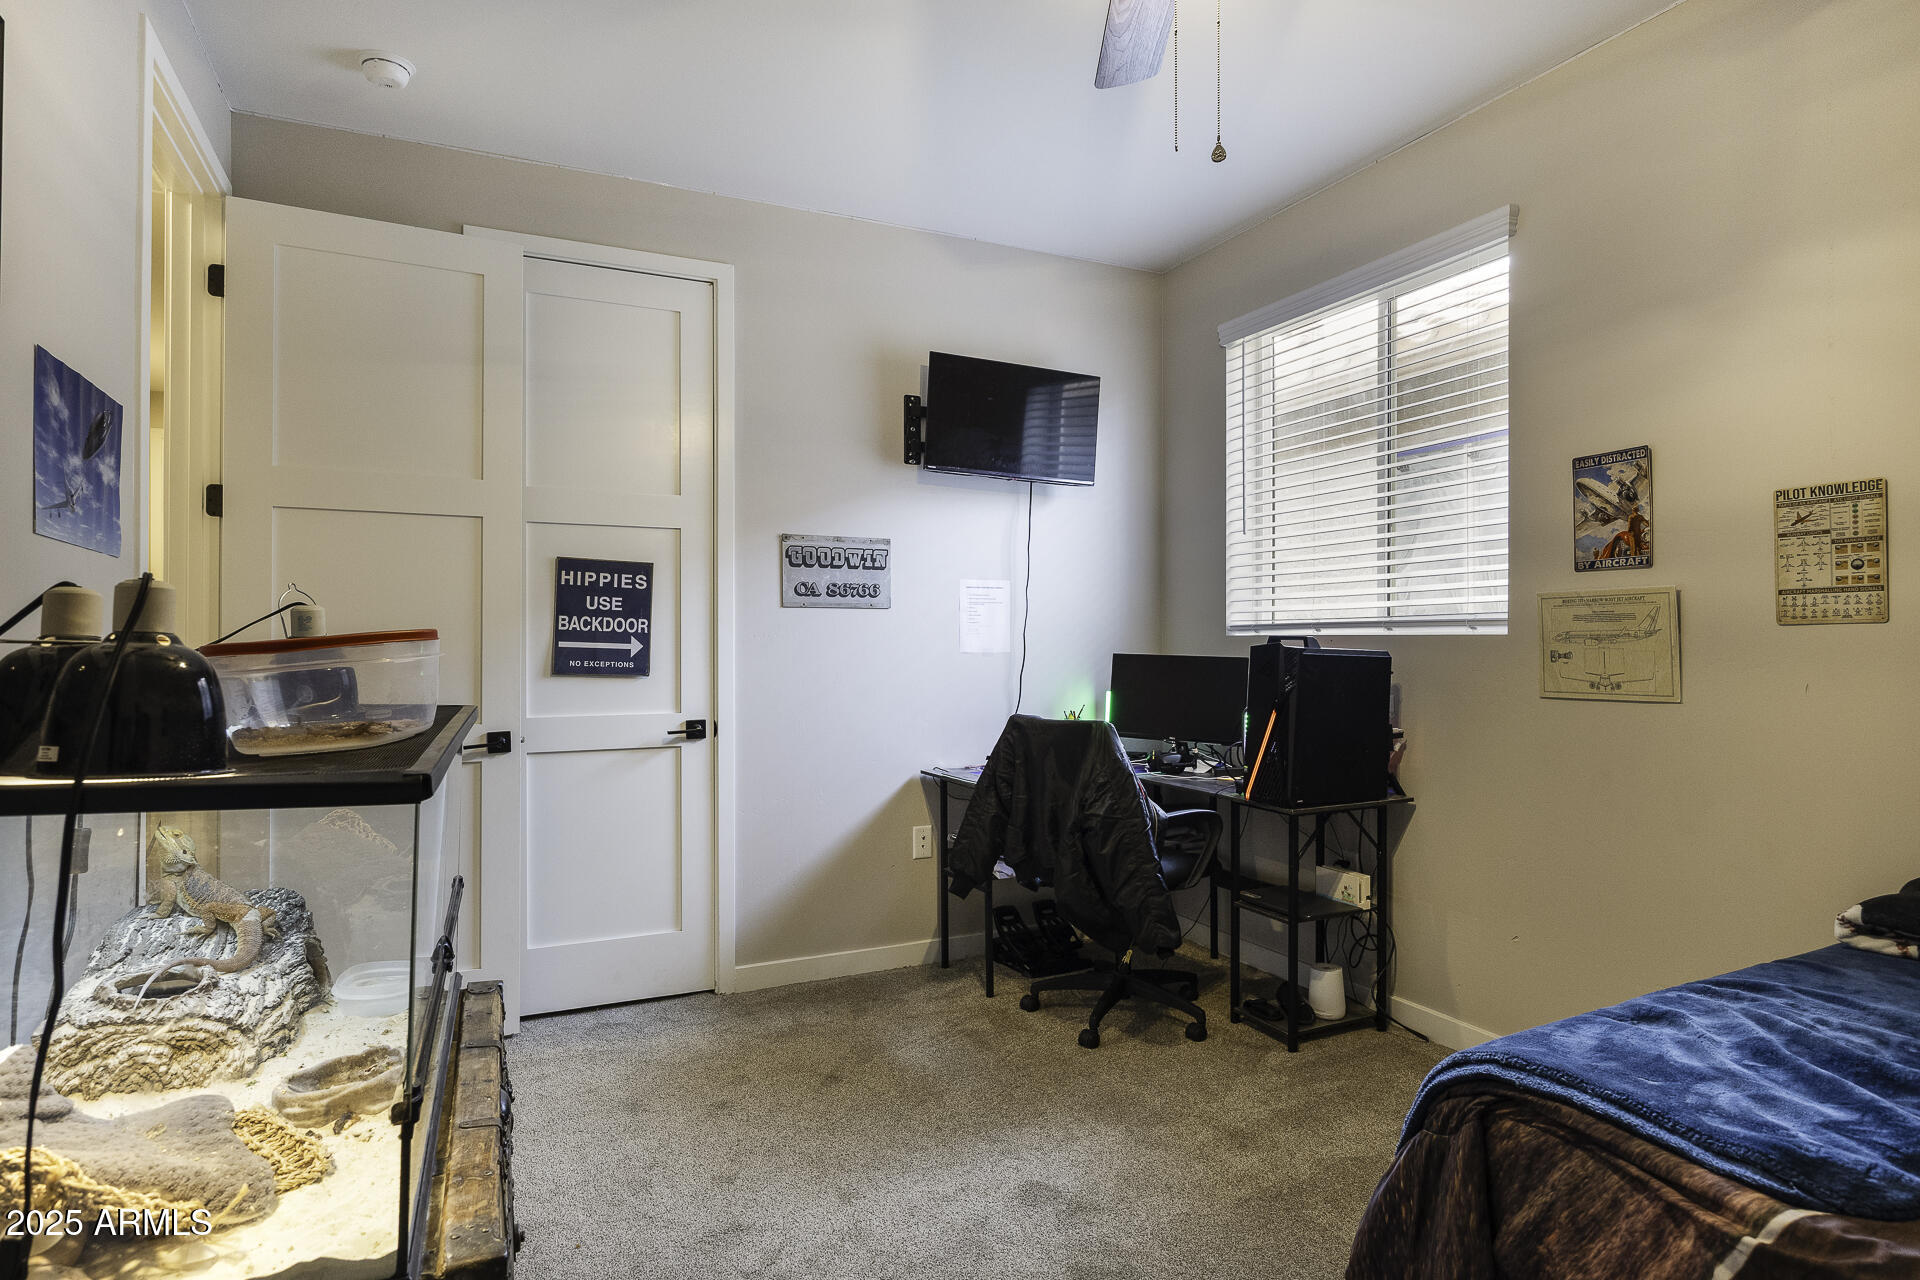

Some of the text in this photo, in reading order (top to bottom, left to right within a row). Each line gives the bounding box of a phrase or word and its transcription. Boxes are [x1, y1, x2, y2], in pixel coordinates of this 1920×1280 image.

[1575, 448, 1646, 469] EASILY DISTRACTED
[1776, 479, 1883, 501] PILOT KNOWLEDGE
[785, 545, 888, 570] GOODWIN
[1577, 556, 1648, 570] BY AIRCRAFT
[560, 570, 648, 590] HIPPIES
[794, 581, 881, 598] CA 86766
[586, 595, 623, 611] USE
[558, 615, 649, 634] BACKDOOR
[583, 660, 635, 668] EXCEPTIONS
